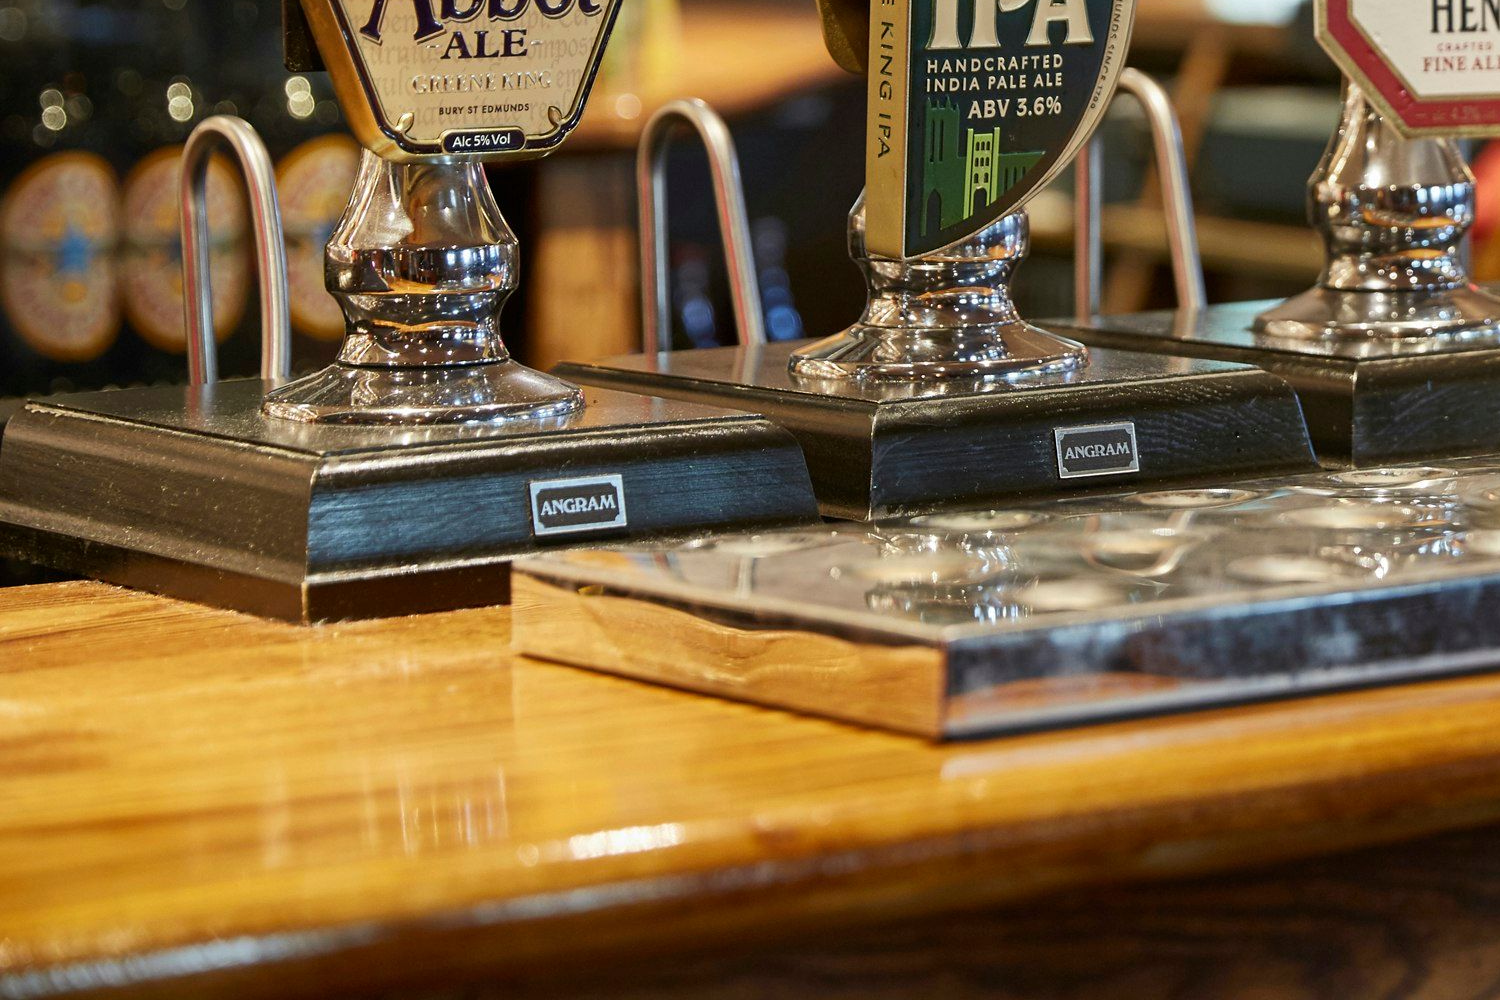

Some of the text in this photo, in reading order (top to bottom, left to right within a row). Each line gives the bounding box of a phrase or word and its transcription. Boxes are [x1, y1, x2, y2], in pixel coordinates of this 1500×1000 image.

[440, 29, 529, 59] ALE
[1437, 41, 1495, 53] CRAFTED
[879, 21, 894, 100] KING
[927, 53, 1063, 74] HANDCRAFTED
[1100, 44, 1115, 81] SINCE
[1423, 55, 1467, 72] FINE
[412, 71, 497, 95] GREENE
[502, 69, 553, 91] KING
[926, 72, 1063, 93] INDIA PALE ALE
[439, 103, 530, 116] BURY ST EDMUNDS
[967, 95, 1062, 119] ABV 3.6%
[452, 132, 511, 148] Alc 5% Vol
[878, 113, 892, 158] IPA
[1064, 441, 1131, 460] ANGRAM
[541, 494, 616, 516] ANGRAM
